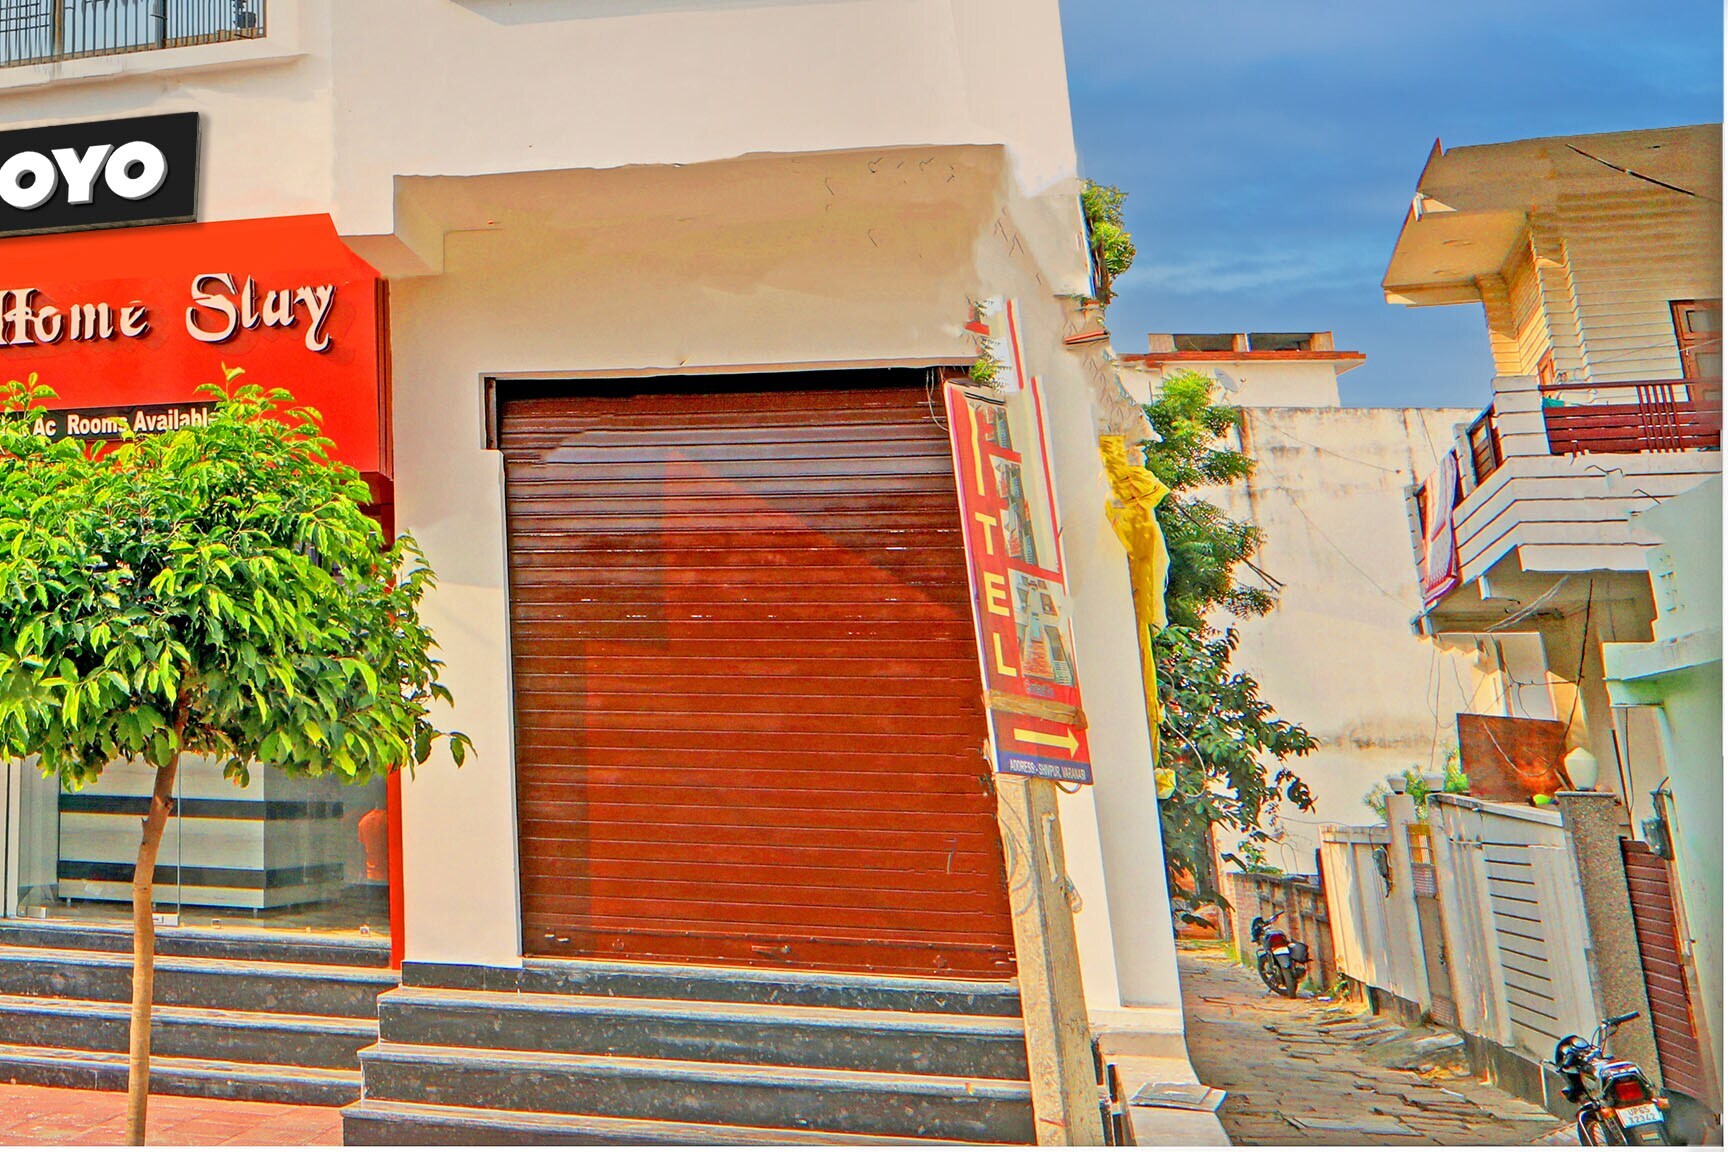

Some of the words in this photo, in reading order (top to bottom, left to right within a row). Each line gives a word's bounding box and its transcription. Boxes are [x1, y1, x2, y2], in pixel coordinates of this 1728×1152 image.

[186, 272, 336, 352] Stay
[32, 417, 57, 437] Ac
[67, 414, 129, 436] Rooms
